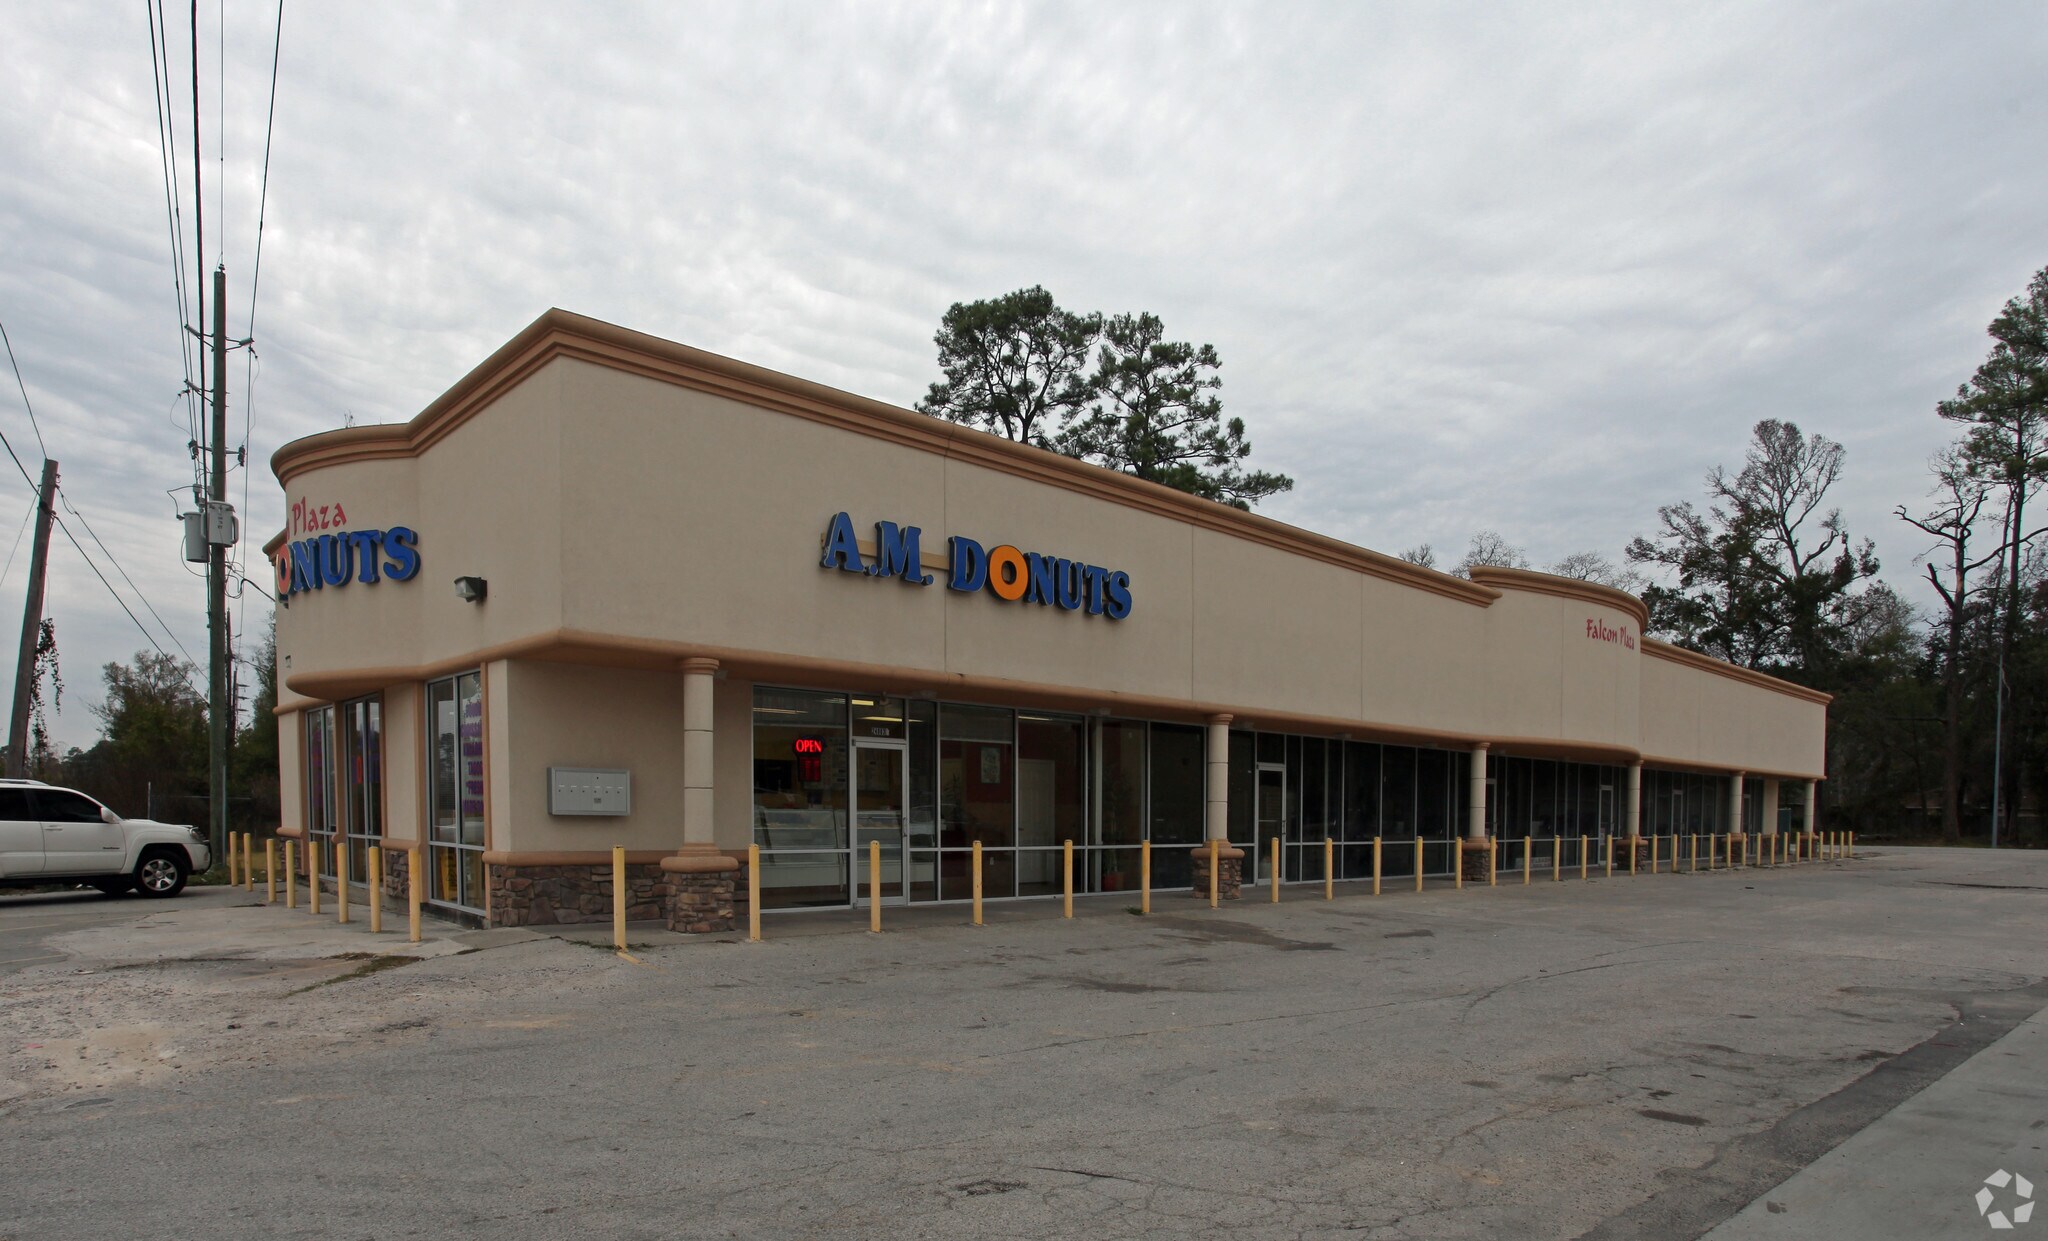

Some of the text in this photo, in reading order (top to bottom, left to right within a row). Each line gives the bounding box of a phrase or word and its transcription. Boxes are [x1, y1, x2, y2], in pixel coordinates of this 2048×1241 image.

[292, 496, 347, 535] Plaza
[276, 526, 420, 597] ONUTS
[820, 512, 1133, 620] A.M. DONUTS
[1586, 618, 1617, 643] Falcon
[795, 739, 823, 753] OPEN
